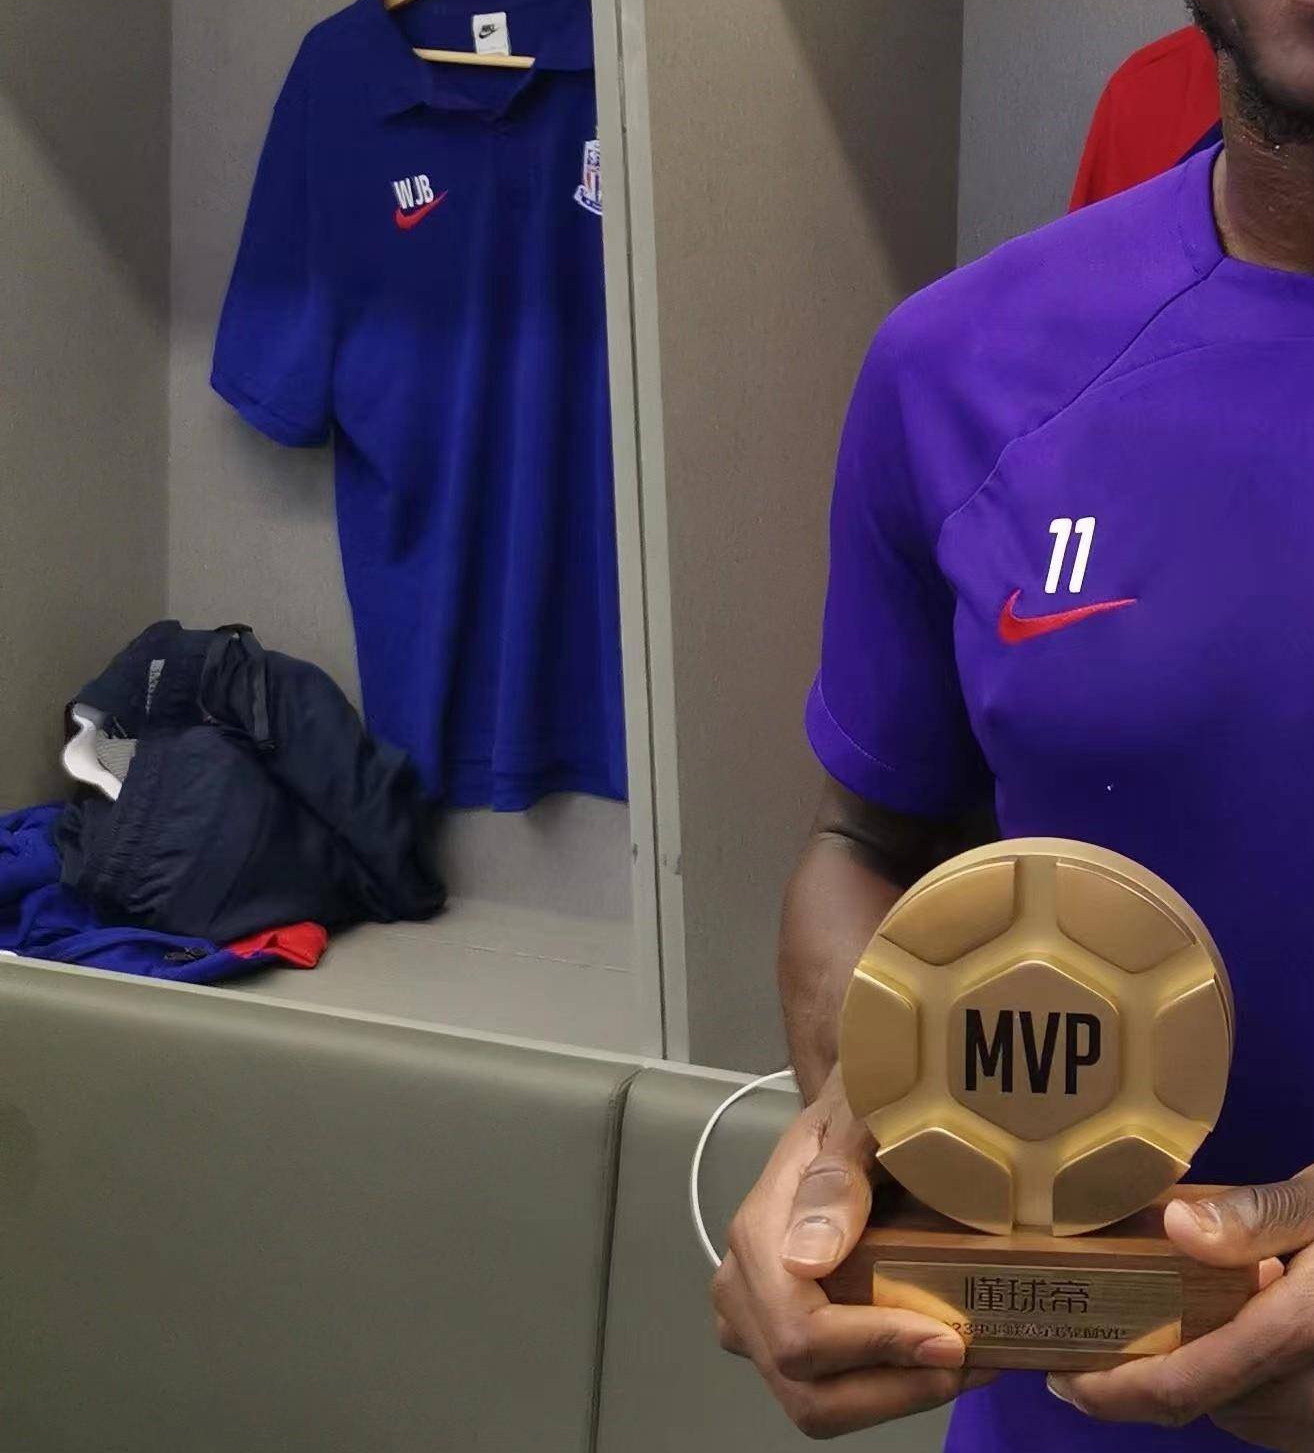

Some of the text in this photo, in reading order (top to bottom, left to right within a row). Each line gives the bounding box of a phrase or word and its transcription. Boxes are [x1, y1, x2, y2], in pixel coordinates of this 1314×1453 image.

[393, 174, 434, 209] WJB
[1045, 516, 1096, 594] 11
[965, 1008, 1102, 1095] MVP
[964, 1276, 1090, 1314] 懂球帝
